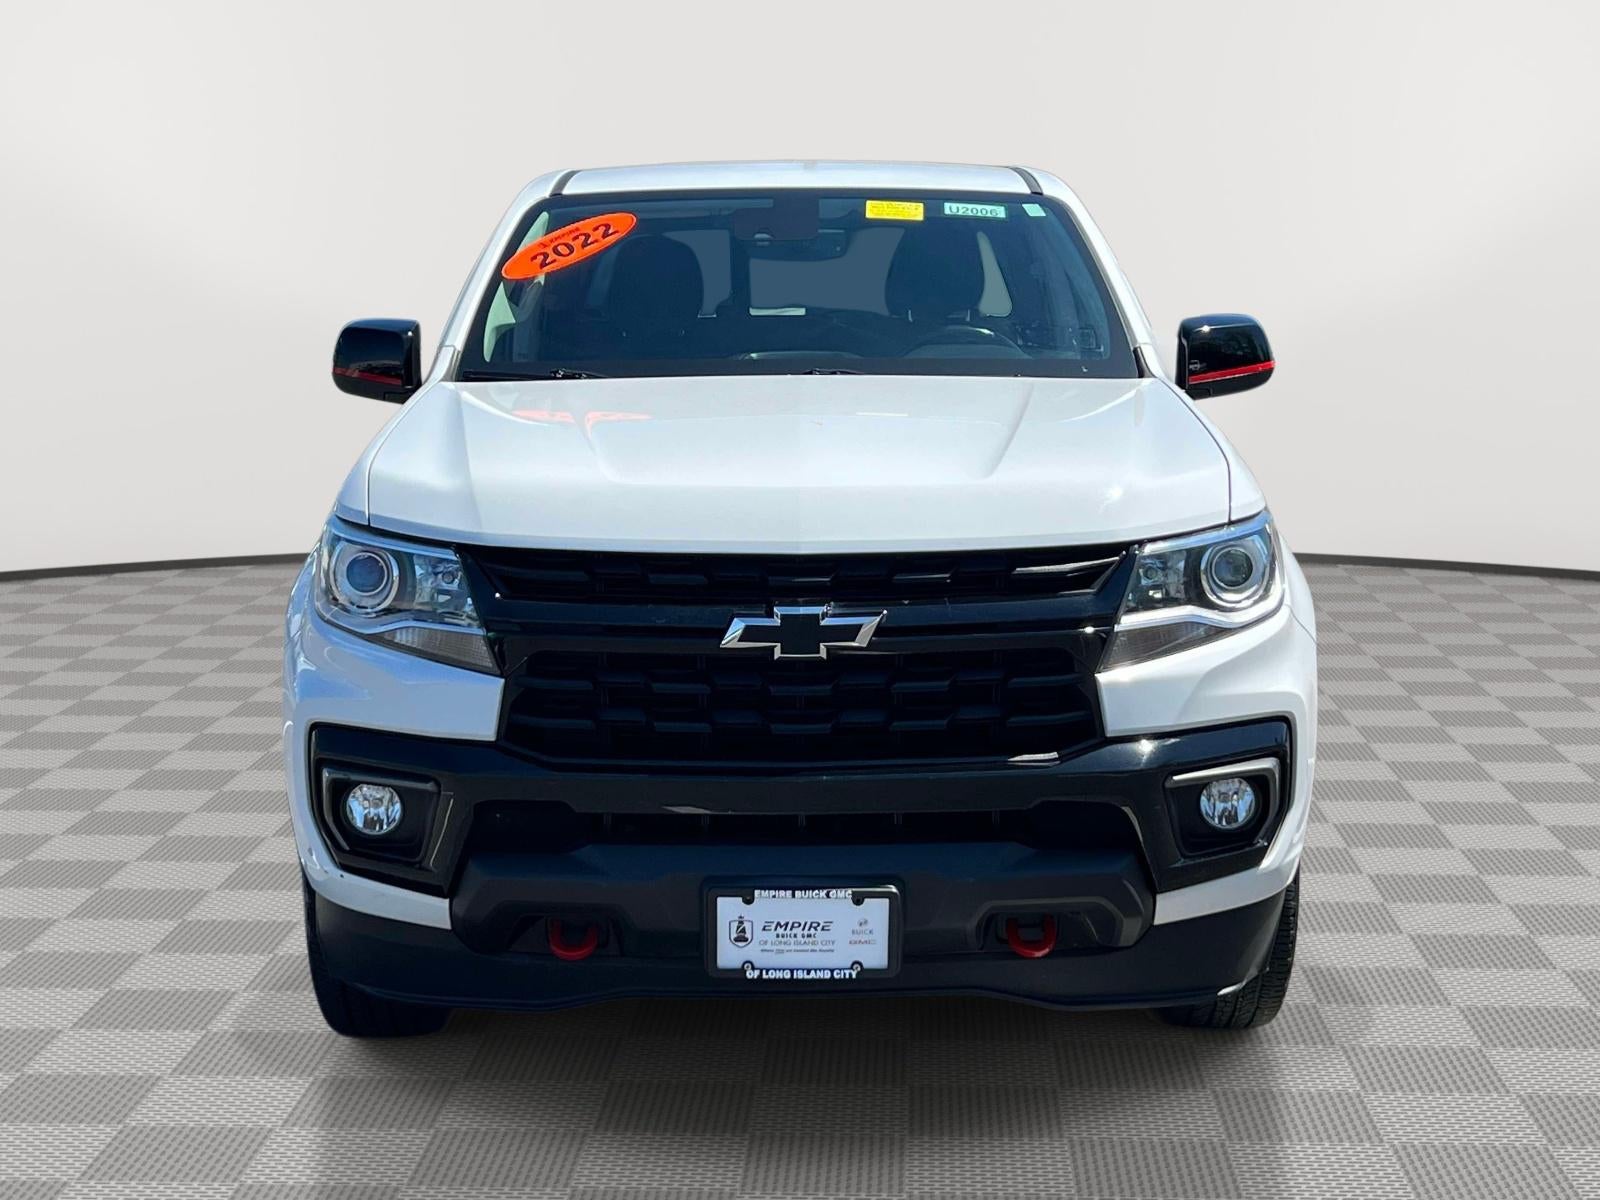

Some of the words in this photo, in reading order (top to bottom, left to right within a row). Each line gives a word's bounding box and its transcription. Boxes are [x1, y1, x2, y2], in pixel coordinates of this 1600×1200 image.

[948, 205, 999, 217] U2006
[530, 223, 619, 269] 2022
[754, 888, 793, 899] EMPIRE
[794, 888, 828, 899] BUICK
[829, 888, 852, 899] GMC
[761, 920, 834, 932] EMPIRE
[746, 968, 760, 979] OF
[762, 968, 791, 979] LONG
[793, 968, 831, 979] ISLAND
[833, 968, 858, 979] CITY
